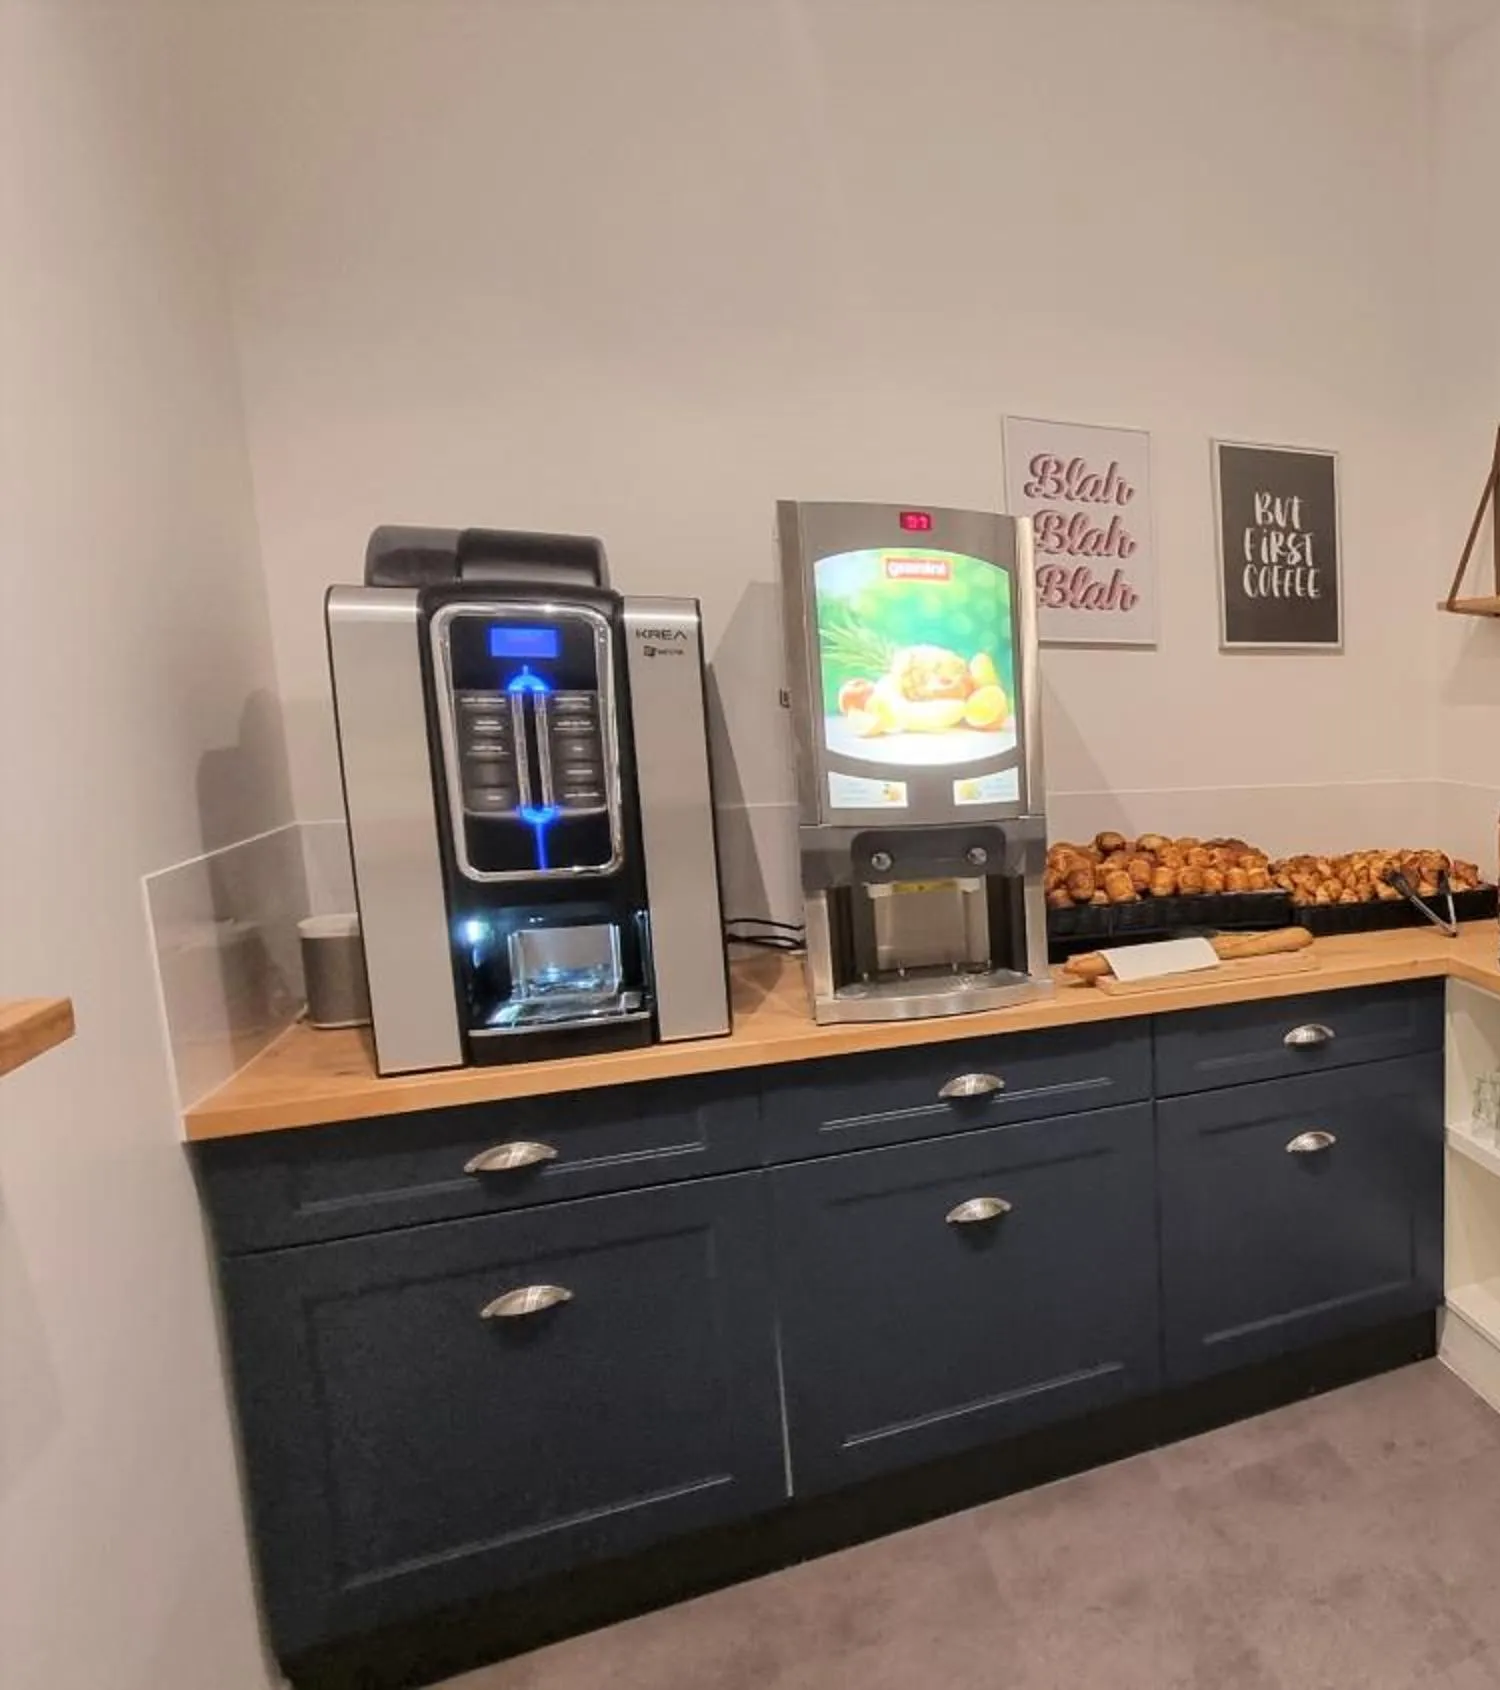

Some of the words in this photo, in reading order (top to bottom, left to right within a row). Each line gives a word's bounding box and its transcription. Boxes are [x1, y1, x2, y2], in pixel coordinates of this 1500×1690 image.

[1024, 453, 1134, 506] Blah
[1254, 491, 1304, 530] BUT
[1033, 509, 1136, 558] Blah
[1035, 563, 1139, 611] Blah
[1243, 563, 1321, 599] COFFEE
[635, 628, 688, 641] KREA
